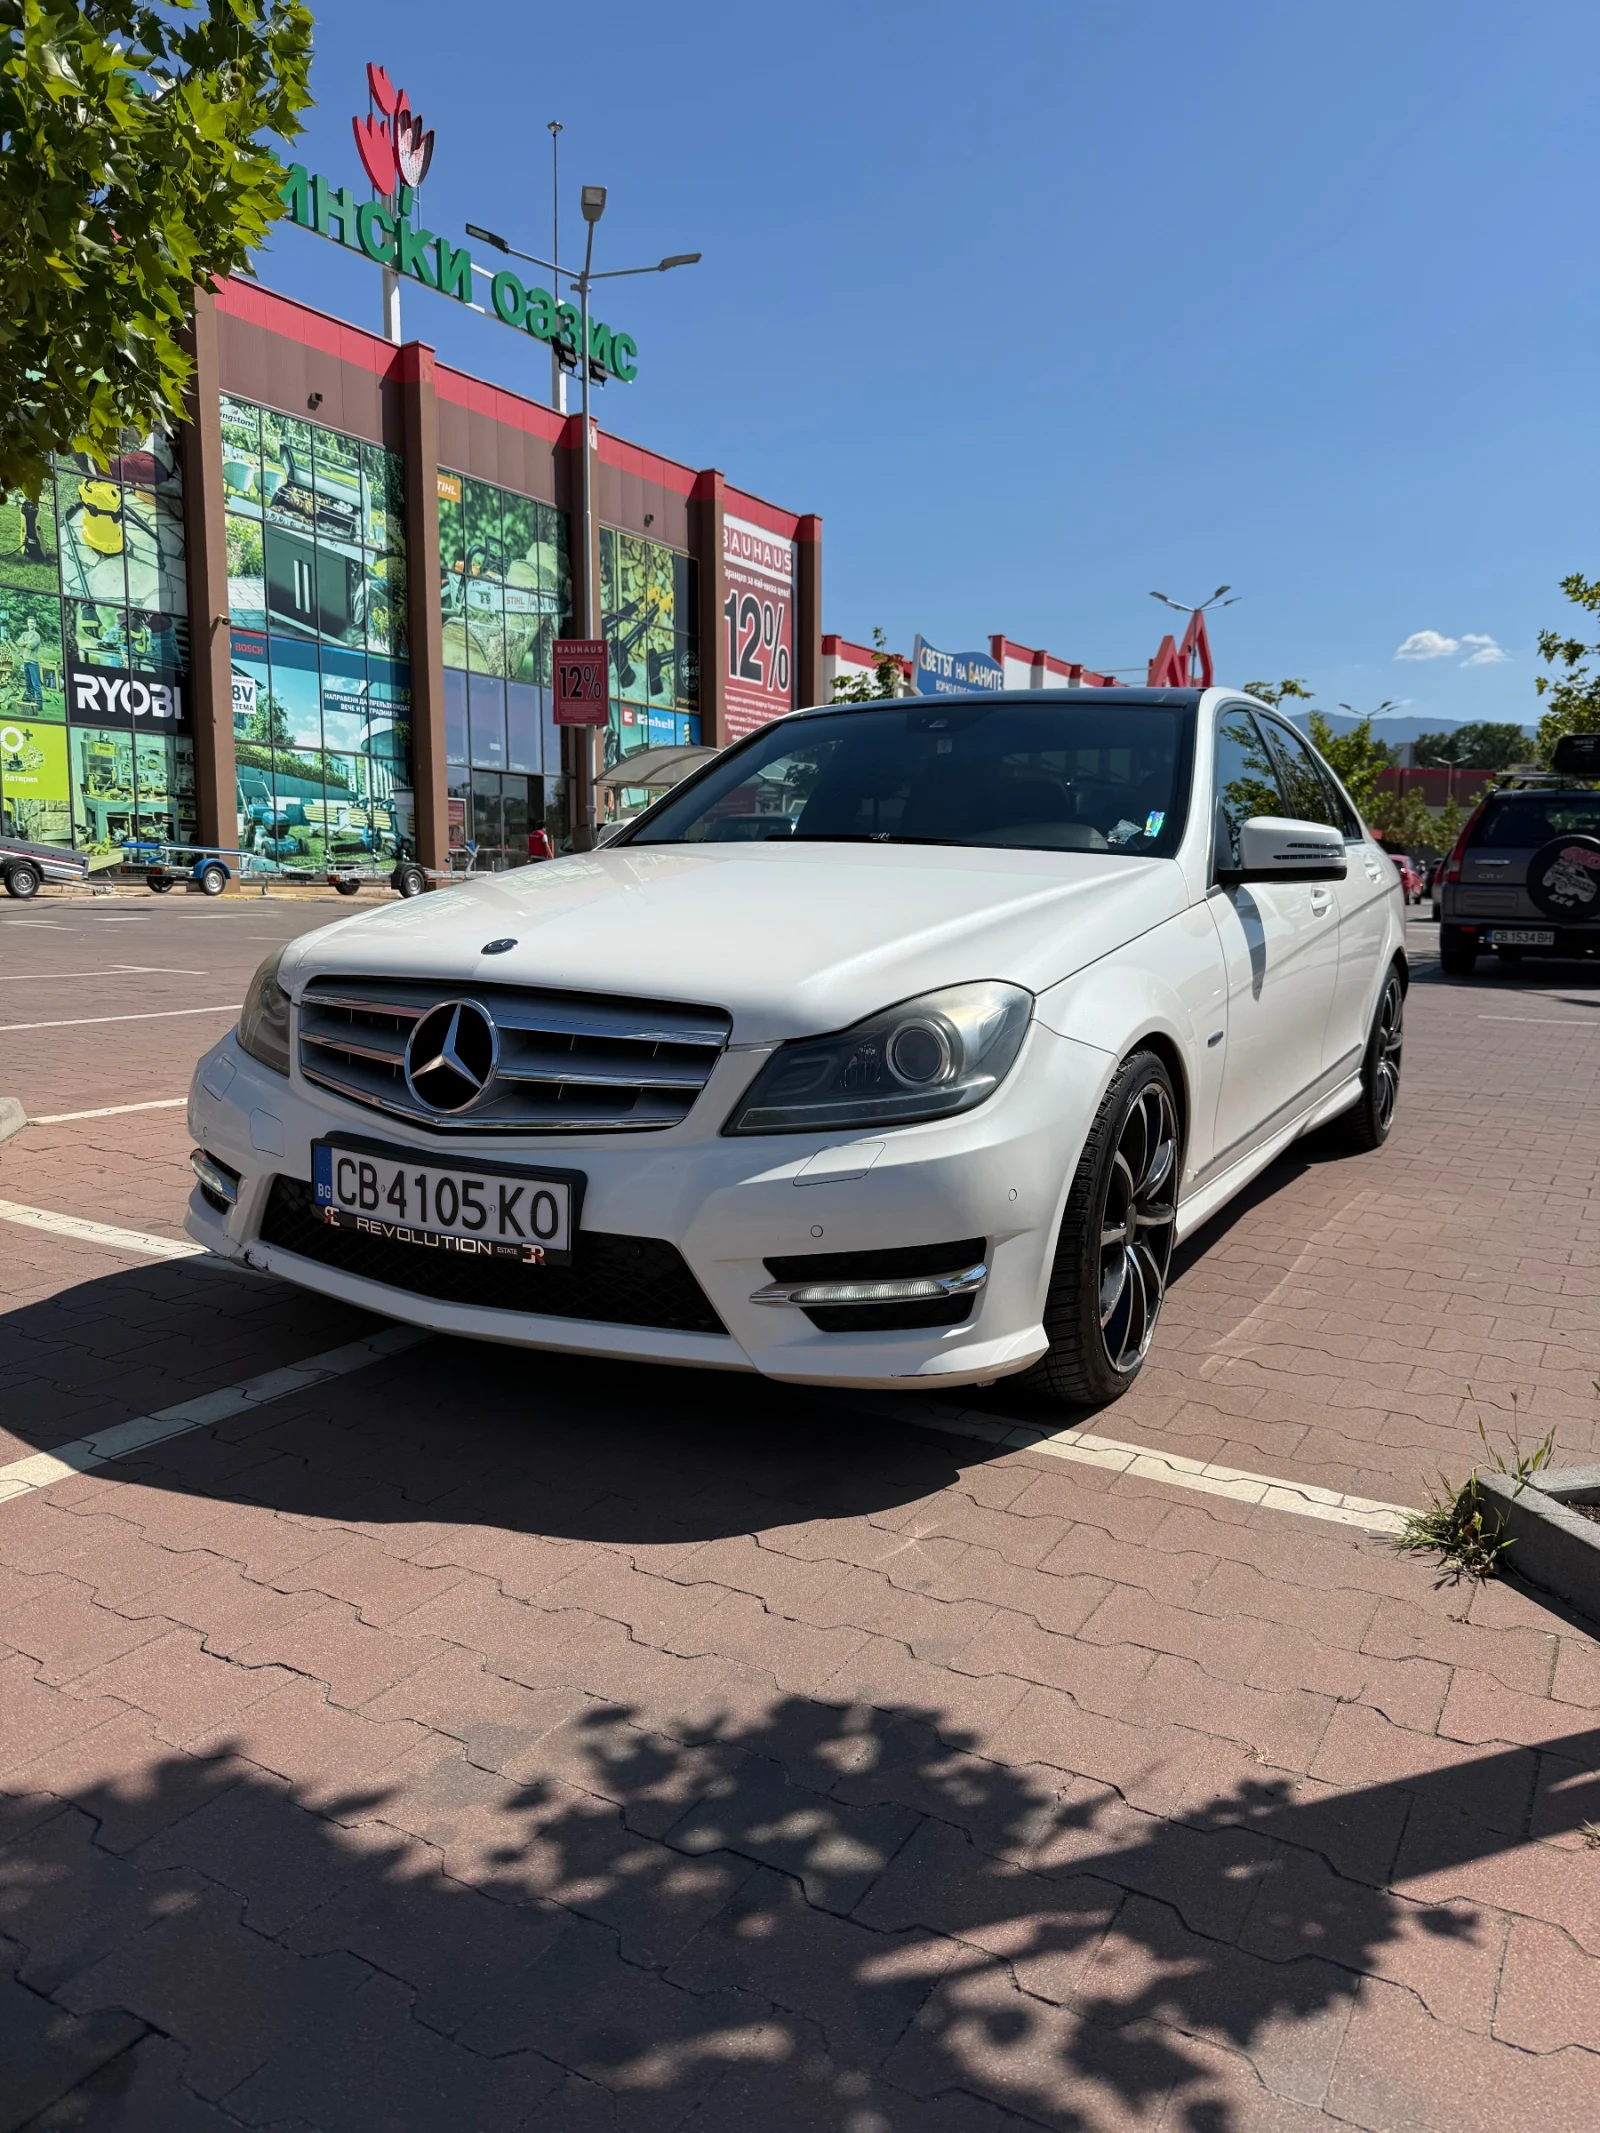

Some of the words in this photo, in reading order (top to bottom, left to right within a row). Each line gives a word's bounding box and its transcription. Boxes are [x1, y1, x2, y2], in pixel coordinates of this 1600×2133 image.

[491, 271, 638, 382] оазис
[235, 643, 263, 655] BOSCH
[557, 646, 603, 654] BAUHAUS
[724, 588, 791, 693] 12%
[559, 664, 603, 700] 12%
[920, 646, 954, 678] СВЕТЪТ
[955, 661, 967, 682] НА
[968, 661, 1003, 691] БАНИТЕ
[73, 673, 182, 720] RYOBI
[636, 713, 675, 730] Einhell
[4, 773, 38, 784] батерия
[1512, 932, 1535, 943] 1534
[317, 1183, 331, 1199] BG
[337, 1157, 379, 1211] CB
[387, 1170, 487, 1231] 4105
[356, 1216, 492, 1255] REVOLUTION
[496, 1246, 518, 1256] ESTATE
